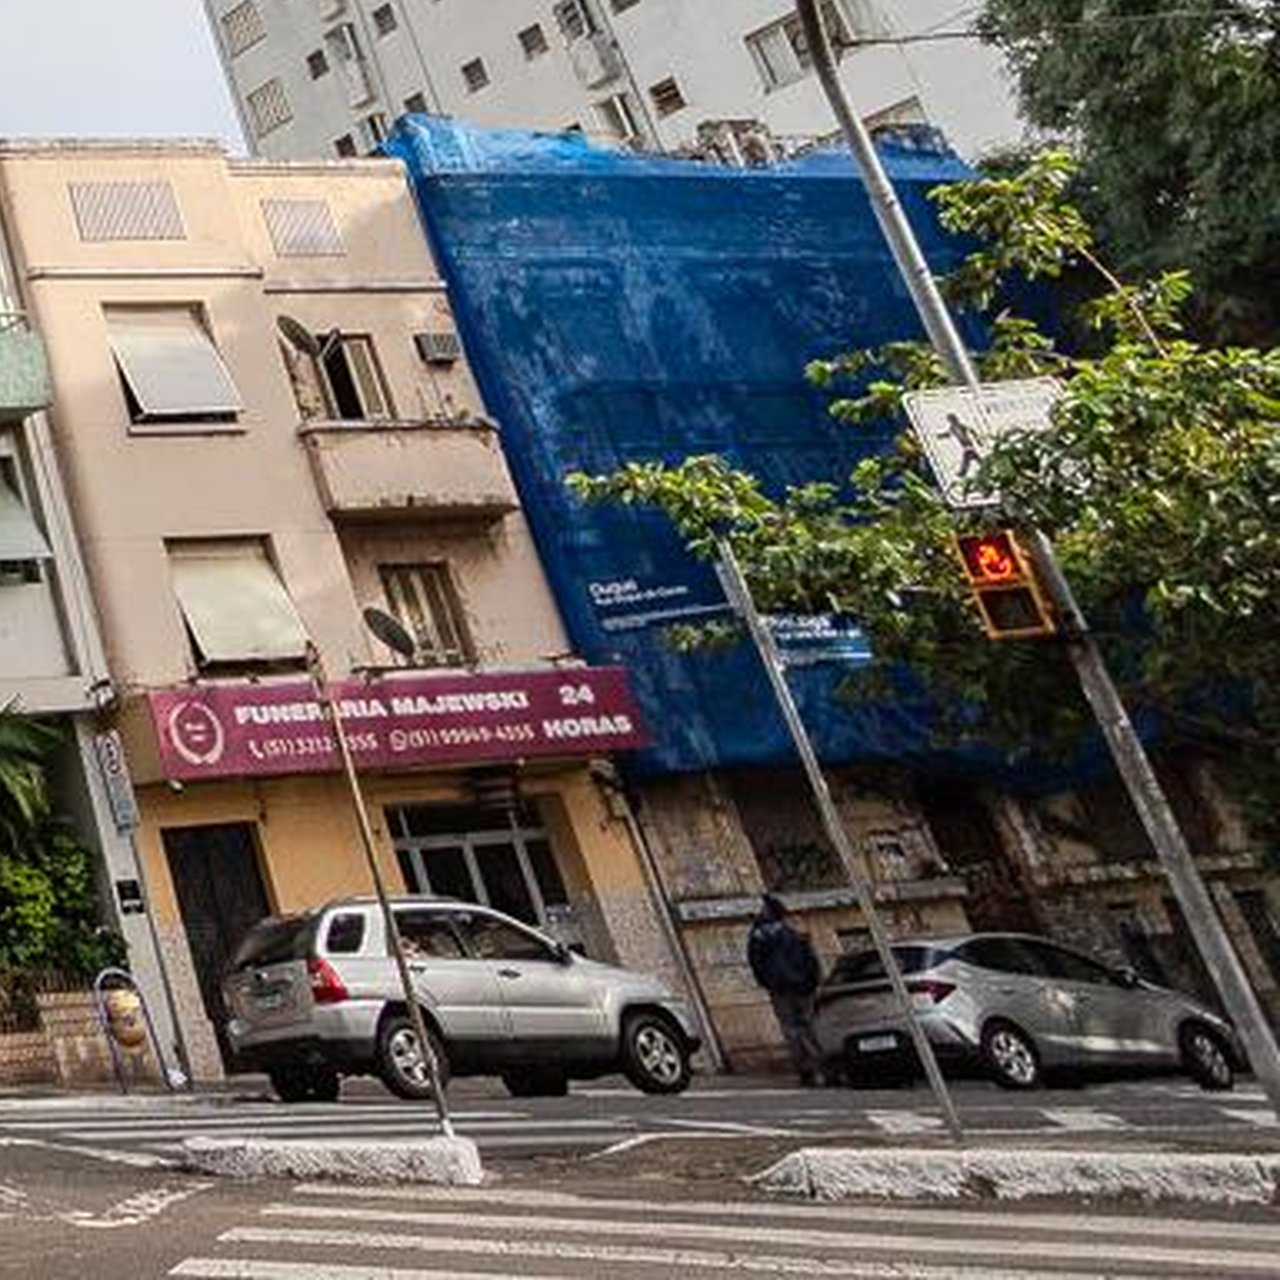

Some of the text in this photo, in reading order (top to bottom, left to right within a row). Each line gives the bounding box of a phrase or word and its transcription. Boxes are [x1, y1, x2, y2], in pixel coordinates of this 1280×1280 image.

[392, 691, 529, 715] MAJEWSKI
[559, 685, 595, 705] 24
[543, 715, 633, 738] HORAS
